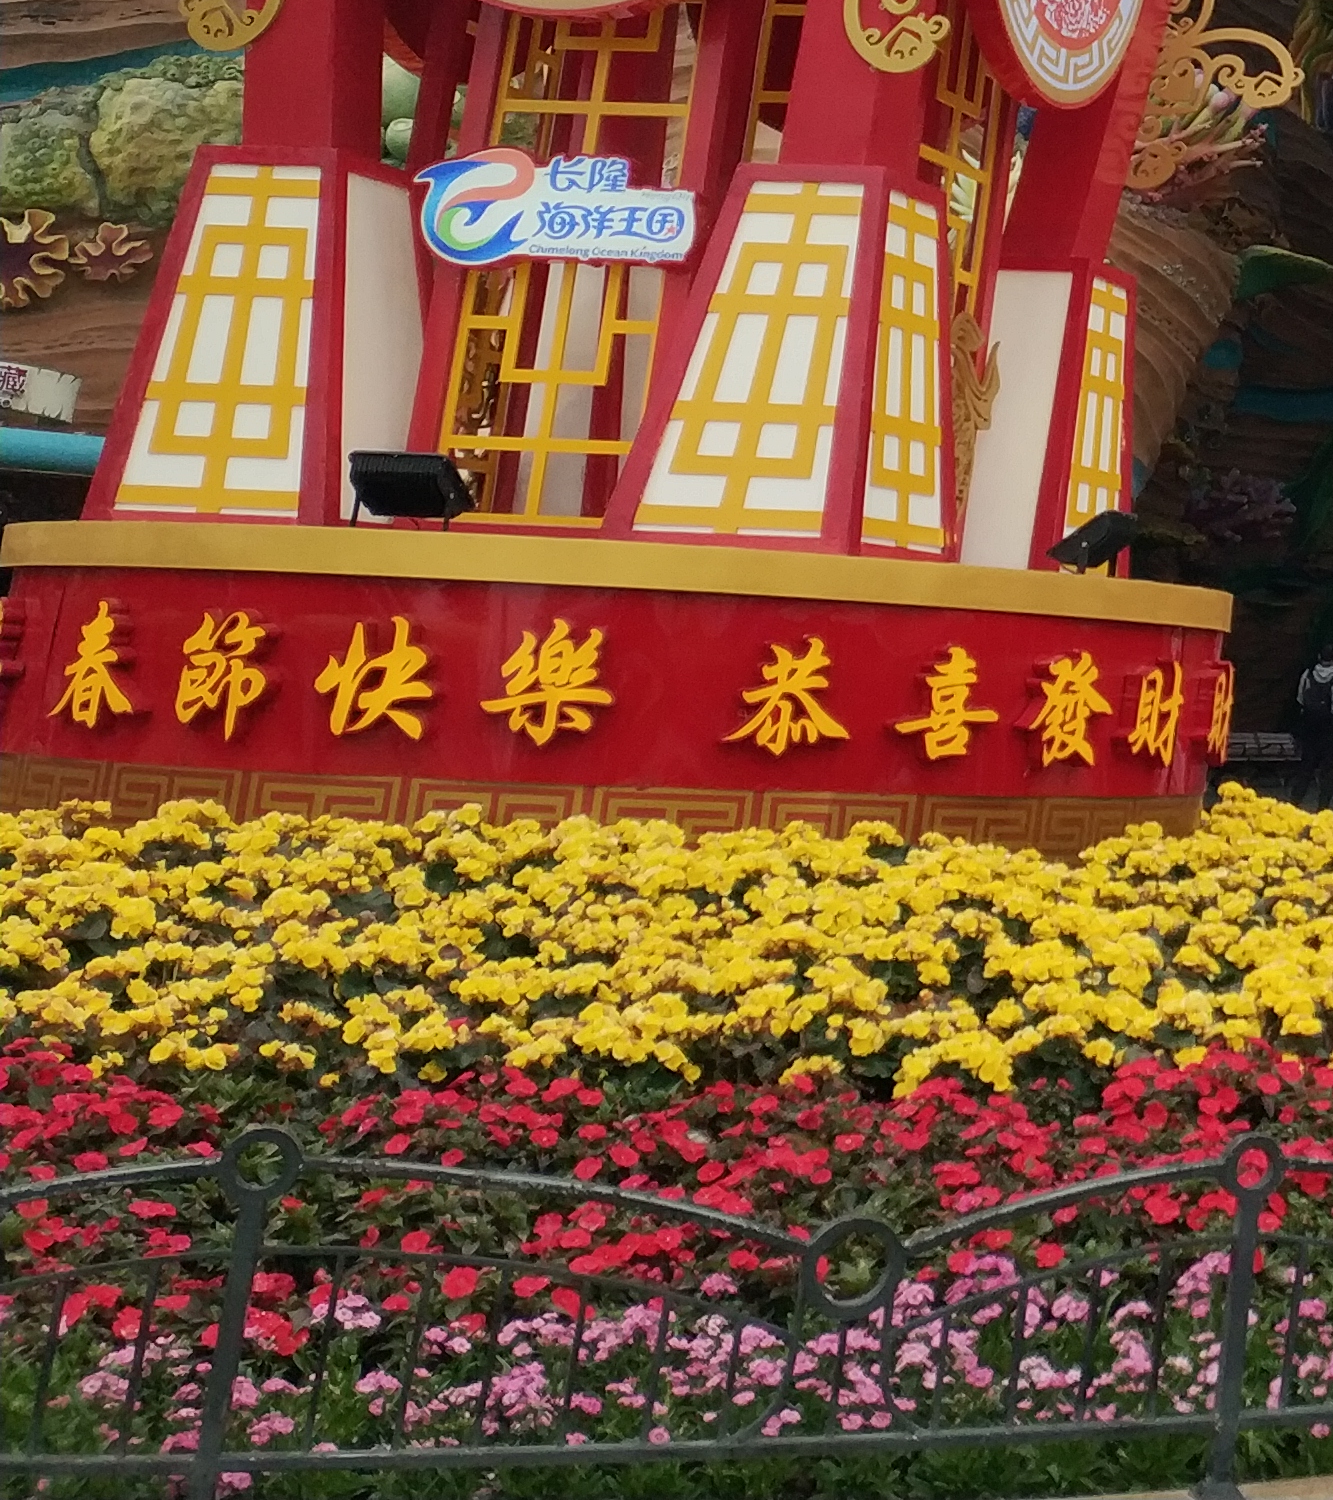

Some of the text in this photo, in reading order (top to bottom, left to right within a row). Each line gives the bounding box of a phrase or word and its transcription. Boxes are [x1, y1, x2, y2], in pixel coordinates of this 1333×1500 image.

[544, 156, 629, 194] 长隆
[532, 201, 685, 241] 海洋王国
[592, 246, 629, 258] Ocean
[630, 246, 684, 263] Kingdom
[47, 600, 613, 747] 春節快樂
[722, 637, 1185, 768] 恭喜發財
